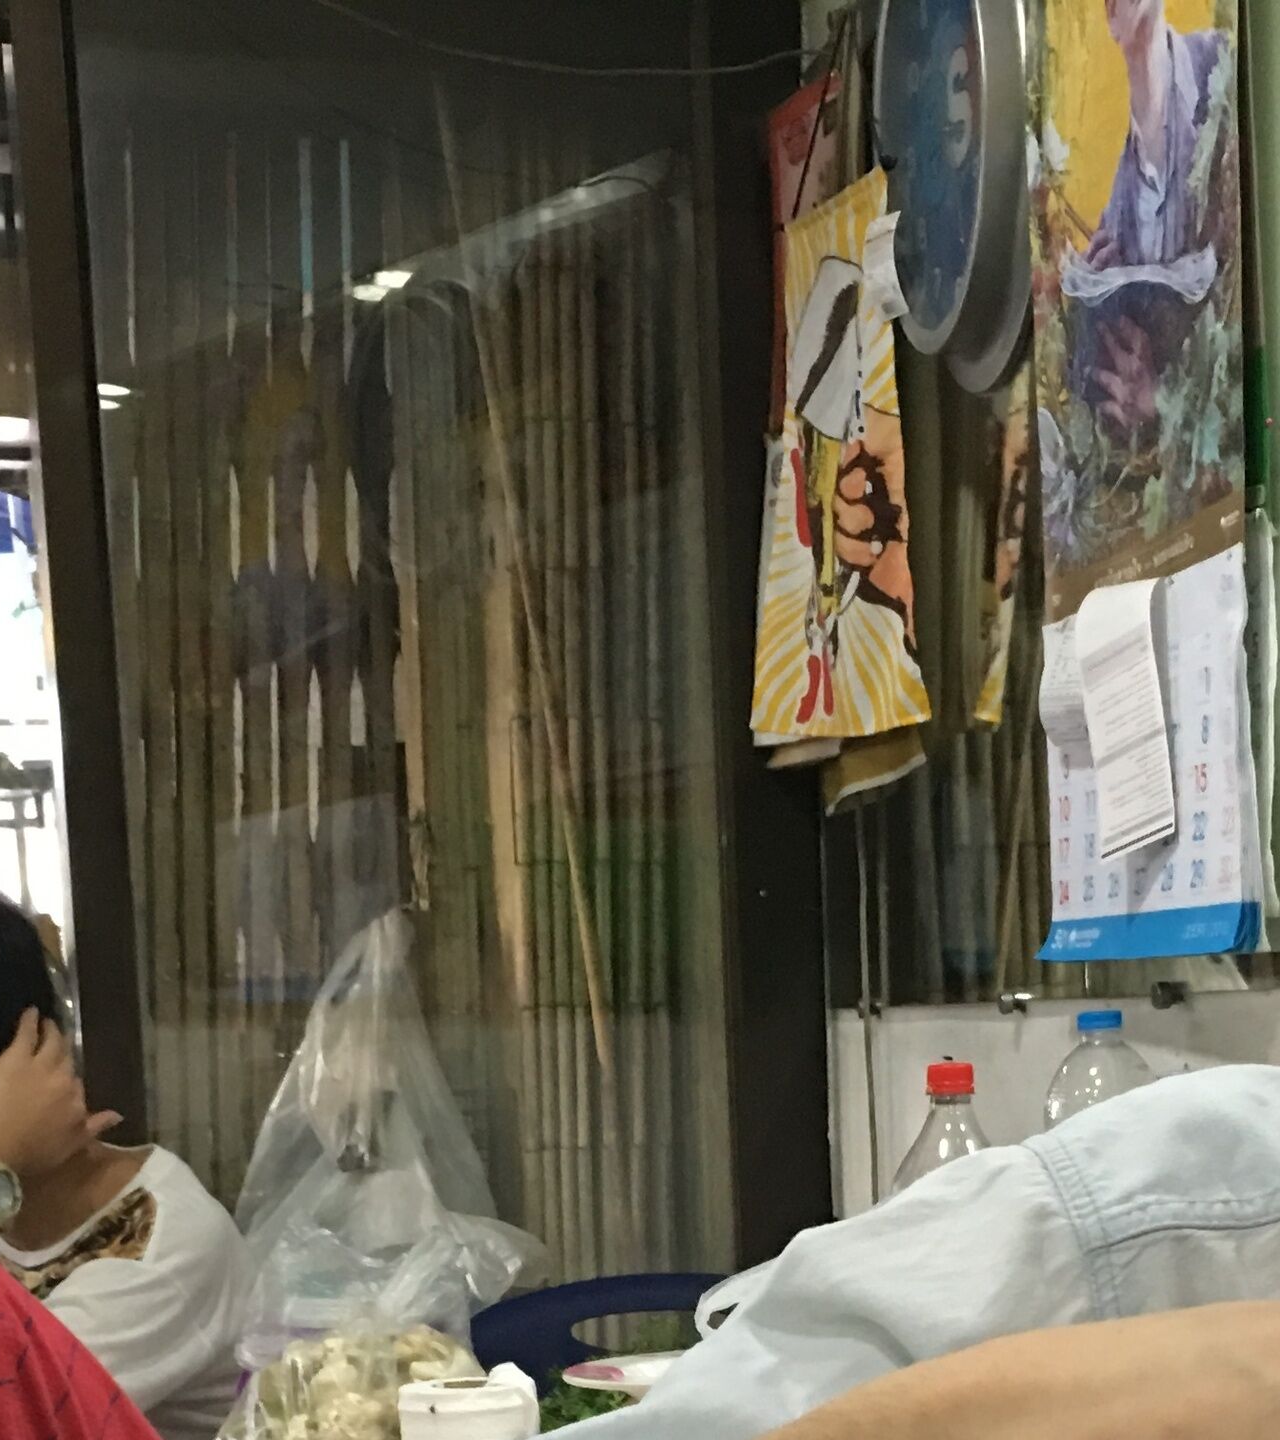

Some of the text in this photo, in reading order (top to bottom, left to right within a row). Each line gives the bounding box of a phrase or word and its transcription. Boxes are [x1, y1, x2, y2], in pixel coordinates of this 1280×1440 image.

[1201, 713, 1209, 745] 8
[1194, 762, 1208, 793] 15
[1059, 795, 1070, 822] 10
[1058, 837, 1070, 863] 17
[1084, 832, 1095, 859] 18
[1059, 879, 1069, 906] 24
[1083, 874, 1094, 902] 25
[1108, 872, 1118, 899] 26
[1160, 862, 1174, 892] 28
